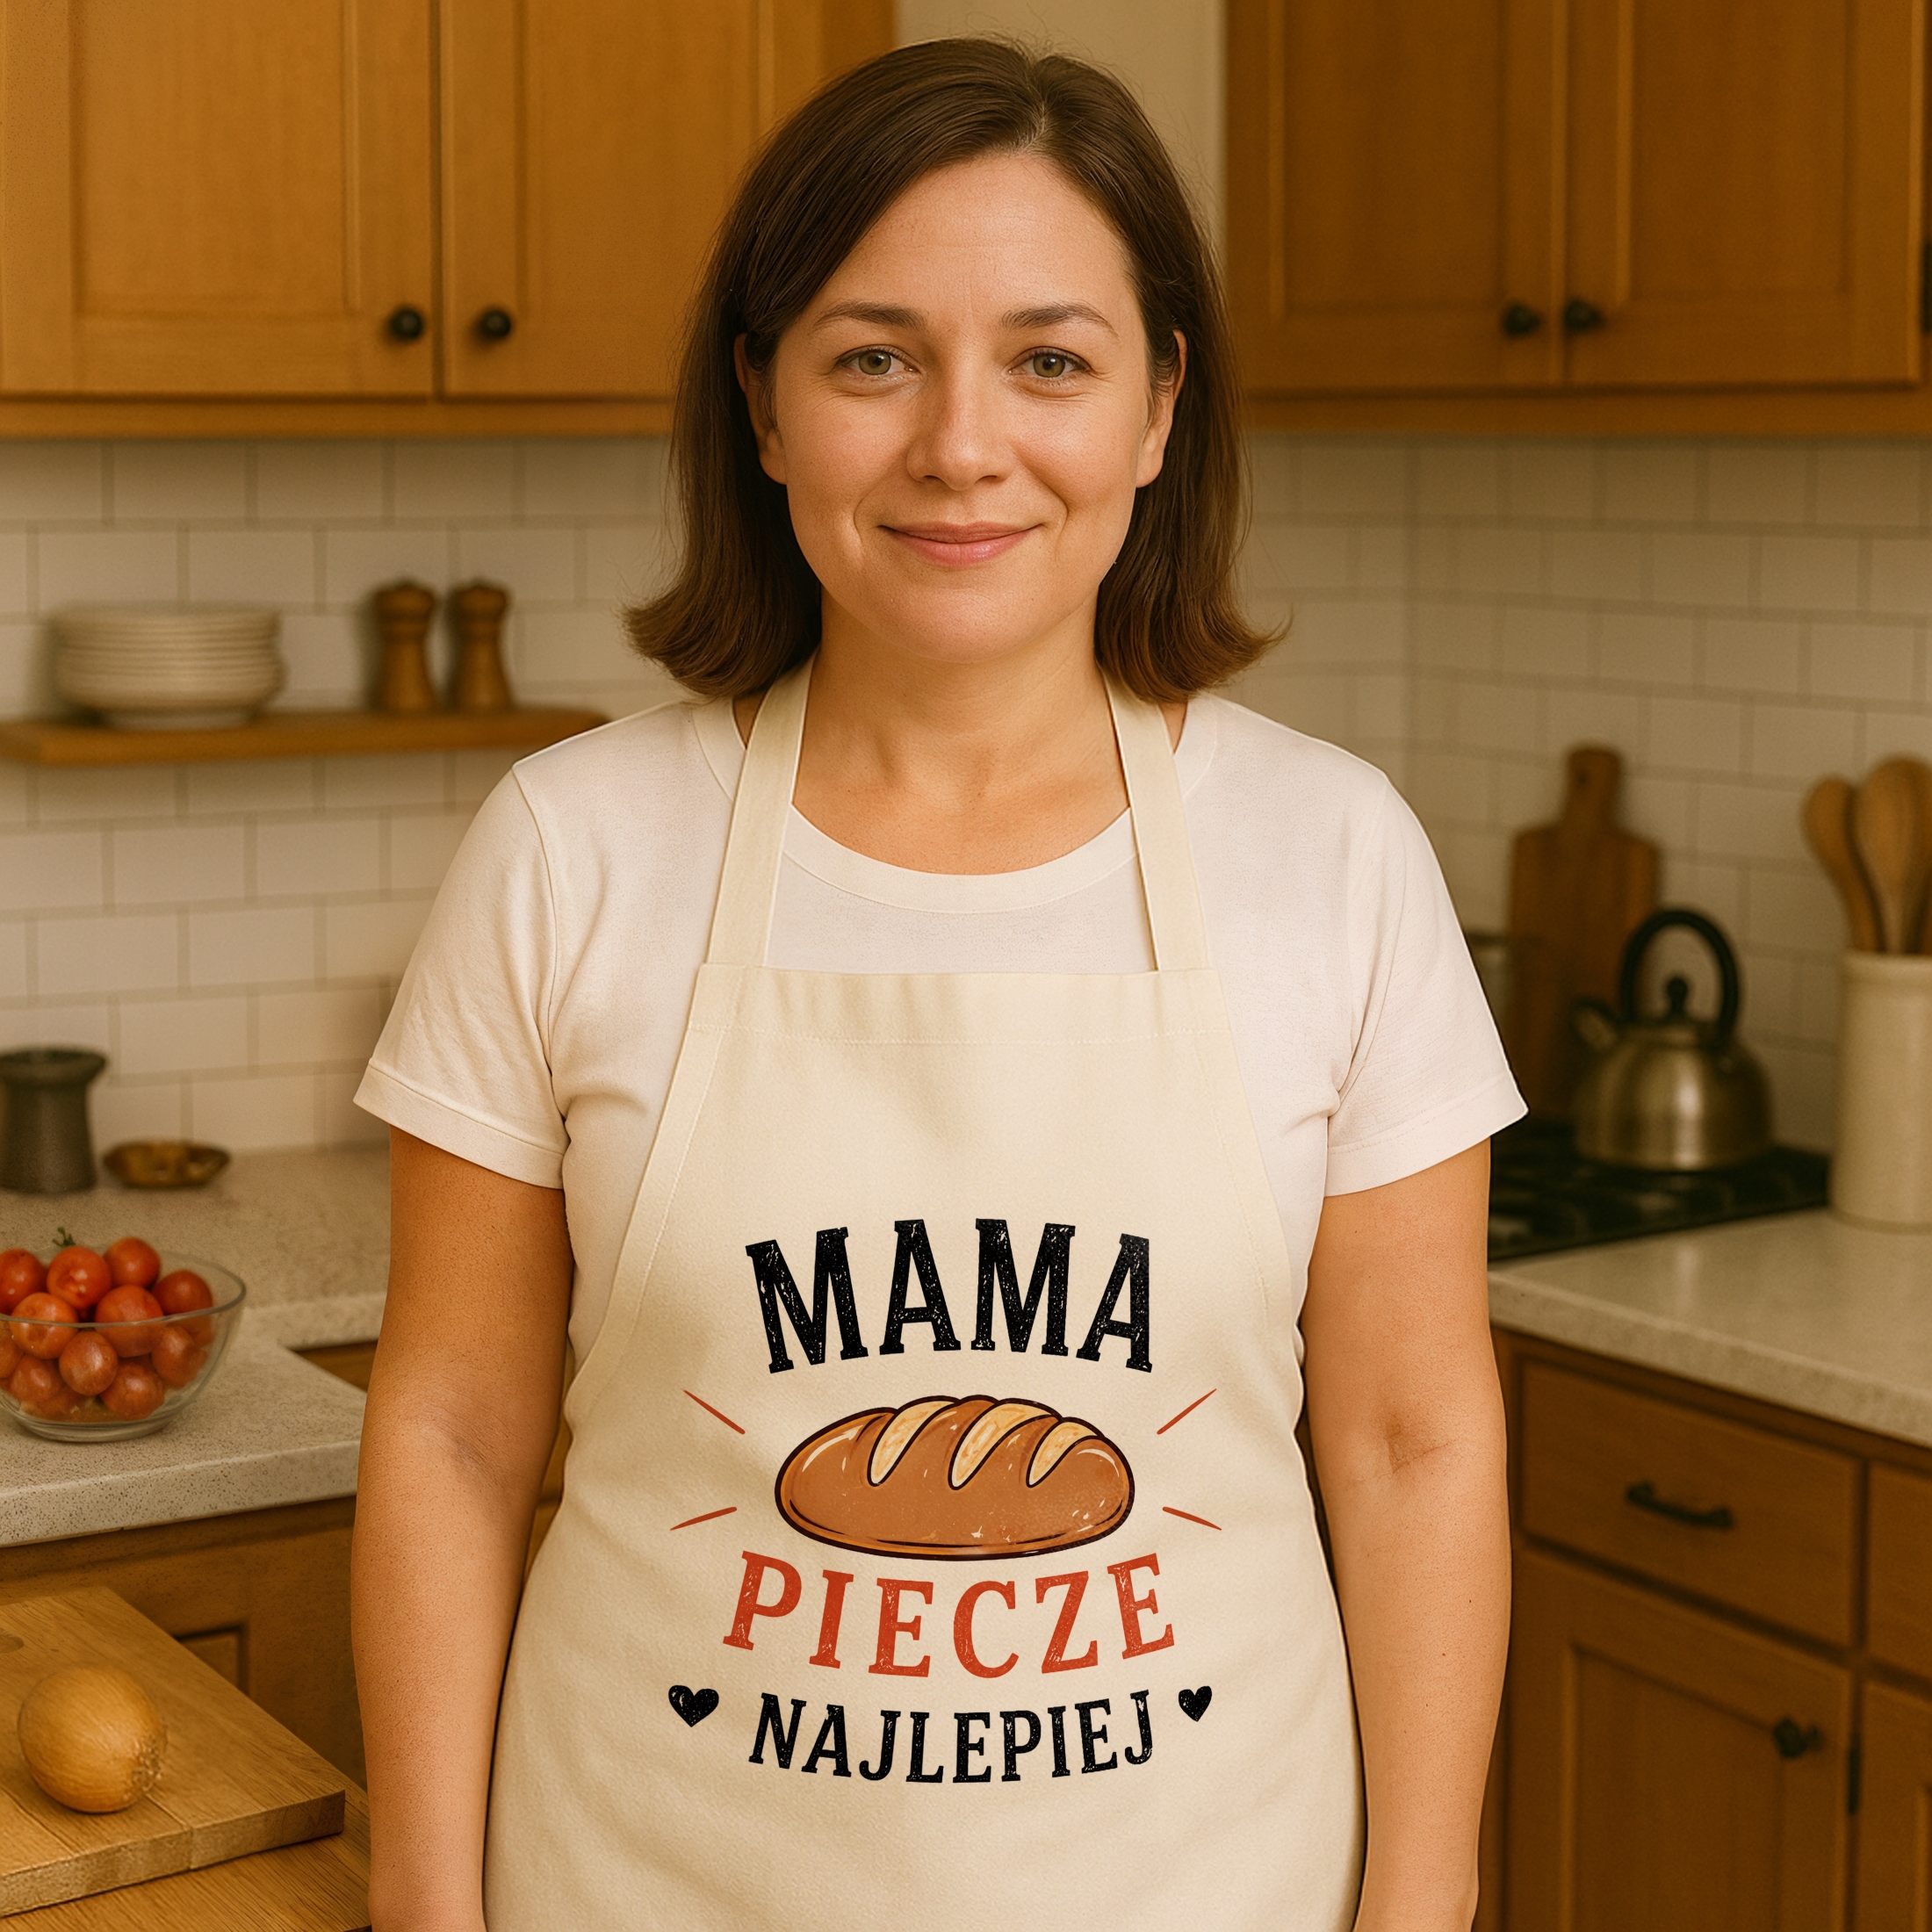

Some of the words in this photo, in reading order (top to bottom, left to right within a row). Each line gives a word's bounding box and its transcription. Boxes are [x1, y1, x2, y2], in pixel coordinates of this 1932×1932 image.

[746, 1218, 1153, 1373] MAMA
[723, 1550, 1175, 1678] PIECZE
[748, 1689, 1153, 1784] NAJLEPIEJ
